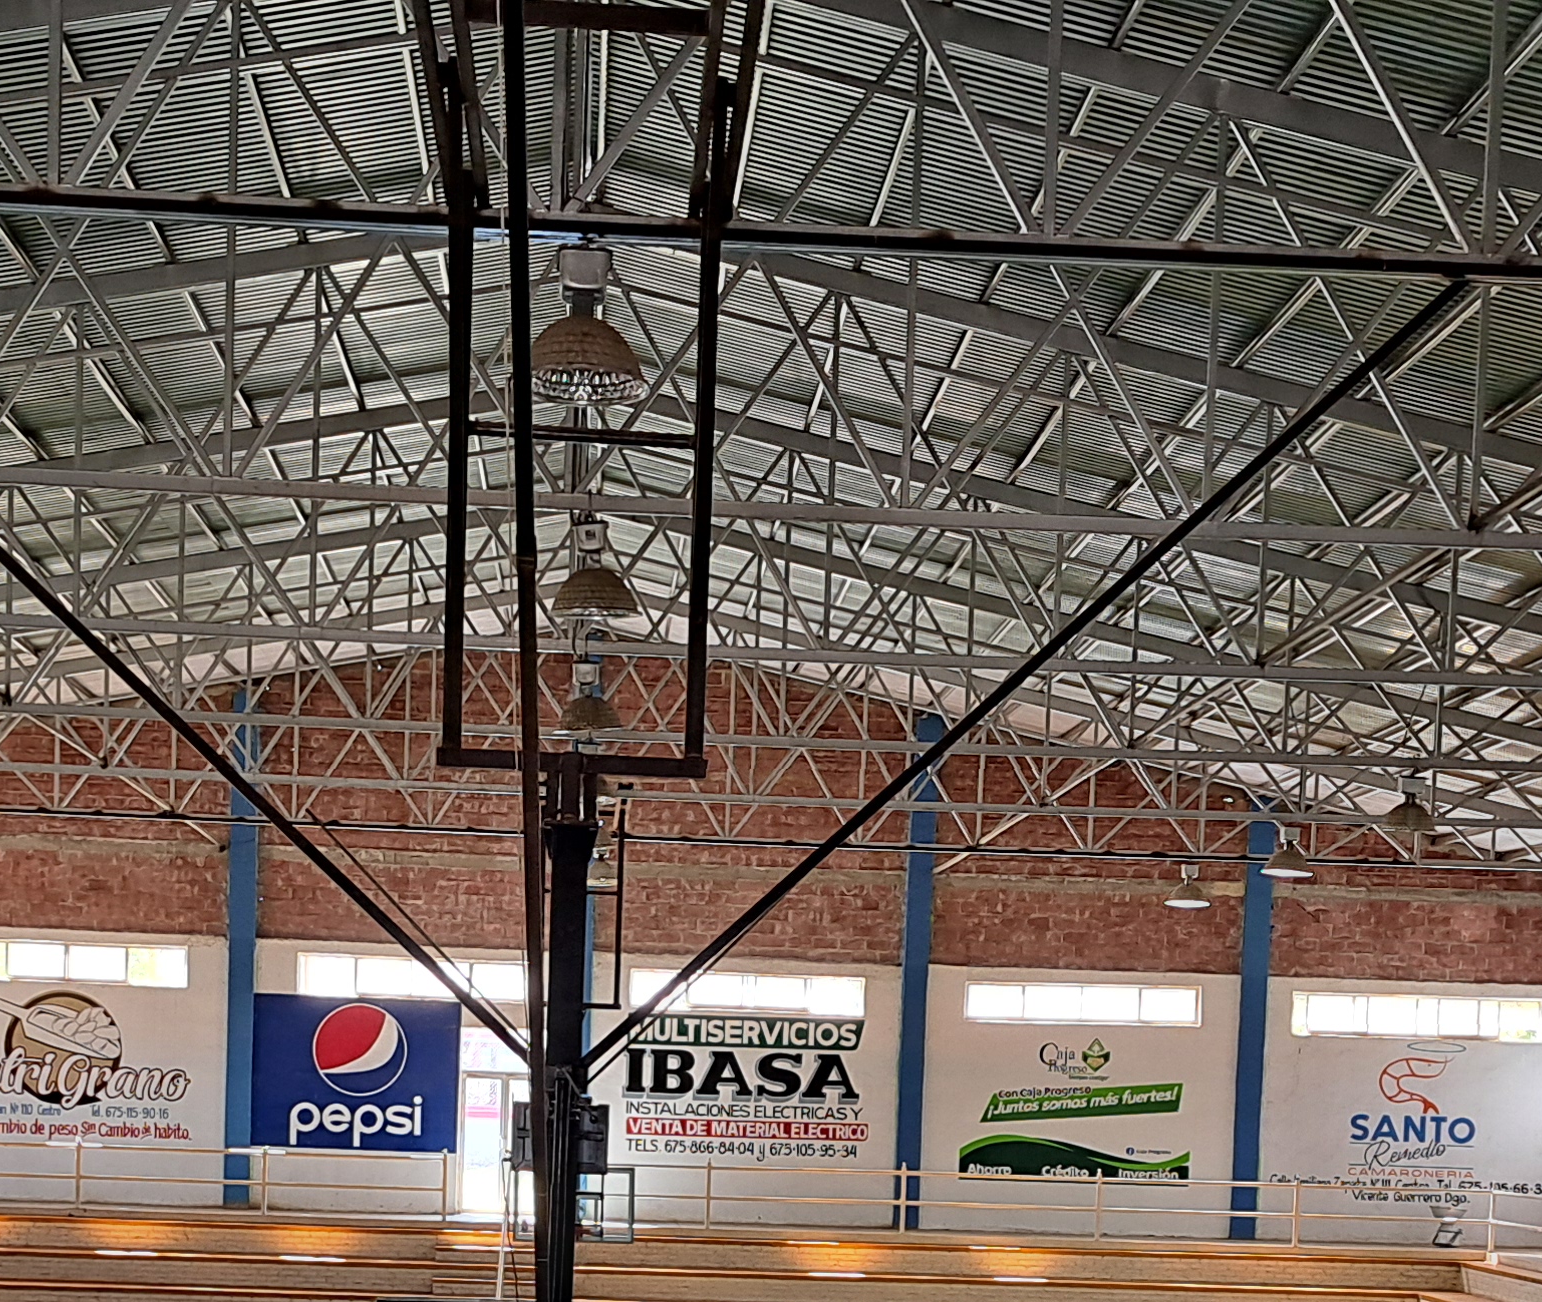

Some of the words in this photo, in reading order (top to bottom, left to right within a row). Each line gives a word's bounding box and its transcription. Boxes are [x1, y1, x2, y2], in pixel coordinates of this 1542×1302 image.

[630, 1017, 857, 1047] MULTISERVICIOS
[622, 1049, 860, 1104] IBASA
[988, 1100, 1039, 1119] ¡Juntos
[1042, 1098, 1088, 1111] somos
[1090, 1092, 1119, 1107] más
[1122, 1086, 1179, 1105] fuertes!
[998, 1089, 1018, 1098] Con
[1020, 1088, 1042, 1099] Caja
[1044, 1086, 1092, 1099] Progreso
[288, 1096, 424, 1147] pepsi
[626, 1101, 750, 1118] INSTALACIONES
[754, 1105, 847, 1120] ELECTRICAS
[850, 1108, 863, 1121] Y
[30, 1118, 45, 1135] de
[49, 1122, 79, 1140] peso
[99, 1122, 140, 1138] Cambio
[629, 1118, 682, 1134] VENTA
[686, 1119, 707, 1136] DE
[711, 1120, 787, 1138] MATERIAL
[791, 1123, 868, 1140] ELECTRICO
[1350, 1114, 1476, 1144] SANTO
[756, 1144, 766, 1161] y
[1364, 1139, 1446, 1170] Remedio
[967, 1163, 1012, 1176] Ahorro
[1041, 1164, 1089, 1178] Crédito
[1118, 1167, 1179, 1180] Inversión
[1347, 1167, 1474, 1178] CAMARONERIA
[1394, 1191, 1441, 1203] Guerrero
